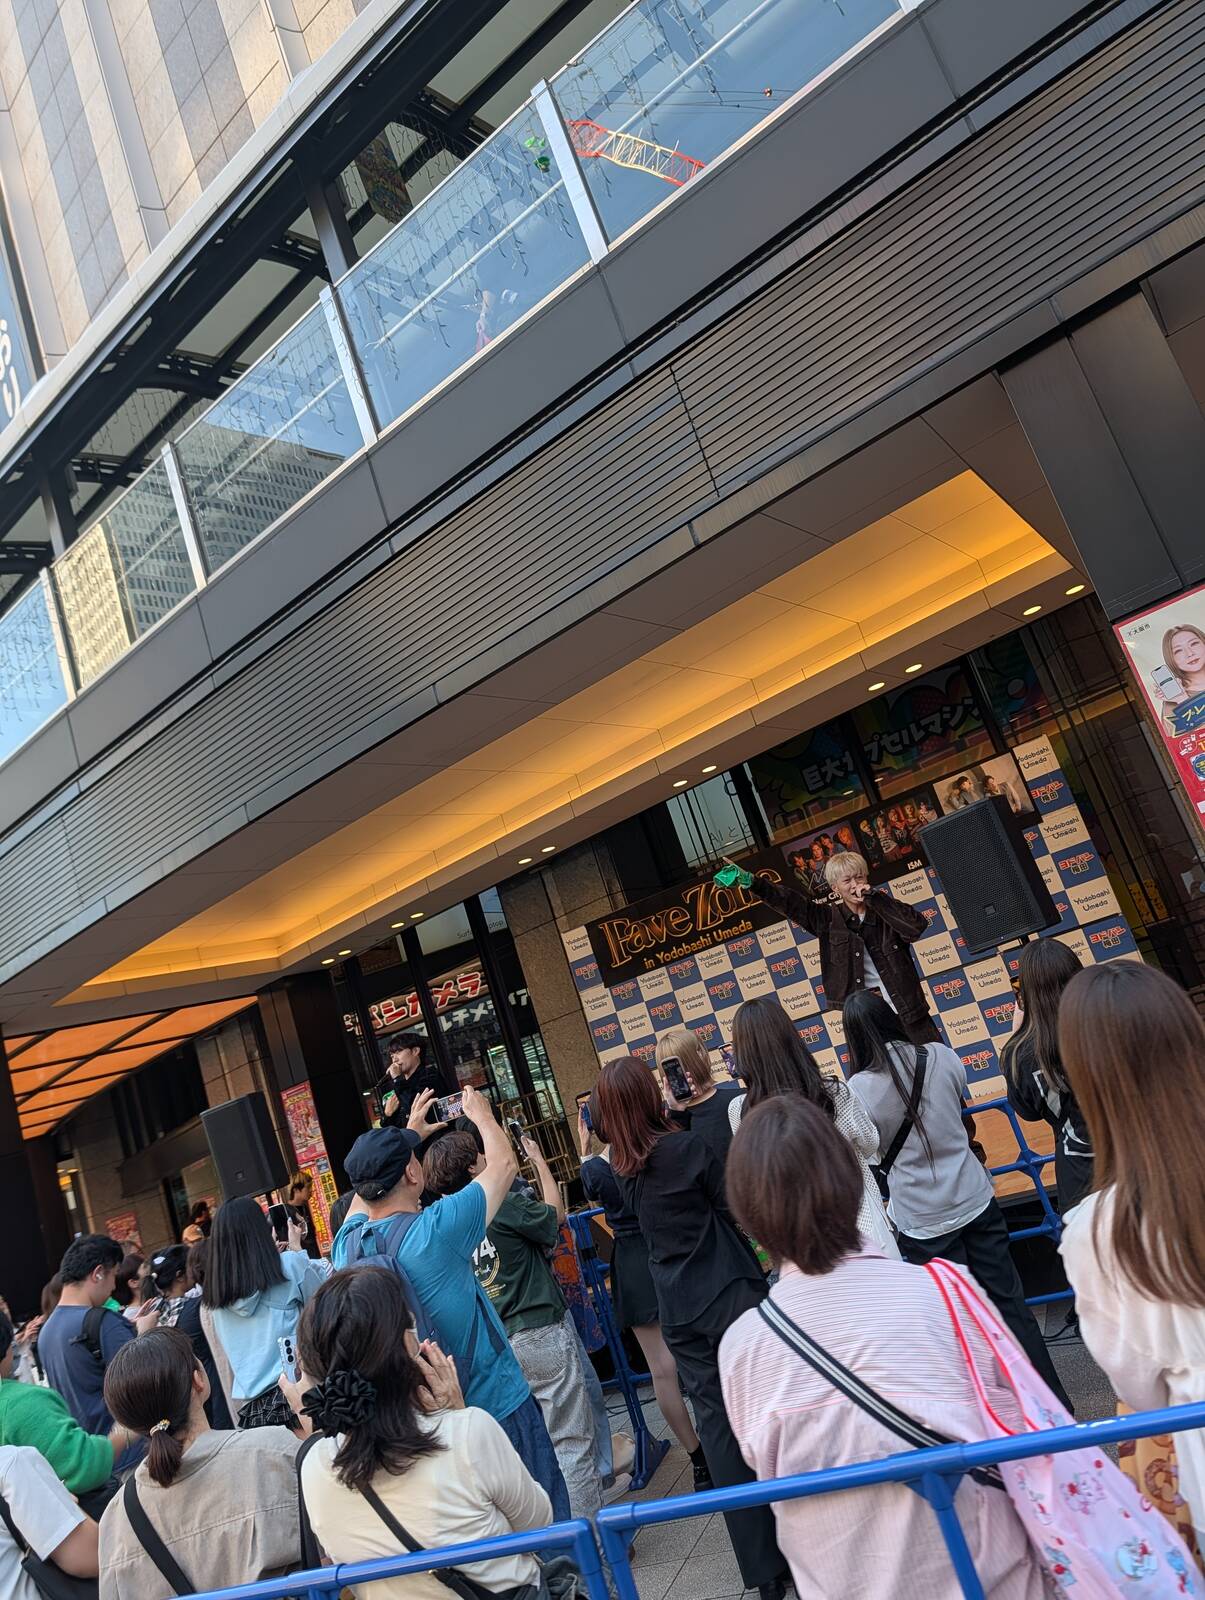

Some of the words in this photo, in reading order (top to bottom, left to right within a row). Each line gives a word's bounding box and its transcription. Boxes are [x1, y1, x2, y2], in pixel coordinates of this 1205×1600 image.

[1044, 816, 1079, 833] Yodobashi
[1052, 827, 1077, 840] Umeda
[1058, 852, 1095, 870] ヨドバシ
[892, 874, 924, 890] Yodobashi
[1074, 889, 1110, 905] Yodobashi
[1082, 900, 1108, 912] Umeda
[599, 906, 693, 968] Fave
[1089, 926, 1126, 943] ヨドバシ
[643, 957, 656, 970] in
[656, 933, 712, 963] Yodobashi
[713, 920, 753, 940] Umeda
[920, 944, 952, 957] Yodobashi
[927, 953, 950, 964] Umeda
[970, 967, 1003, 982] Yodobashi
[978, 977, 1002, 988] Umeda
[933, 978, 966, 995] ヨドバシ
[947, 1015, 980, 1028] Yodobashi
[954, 1025, 978, 1036] Umeda
[960, 1050, 994, 1066] ヨドバシ
